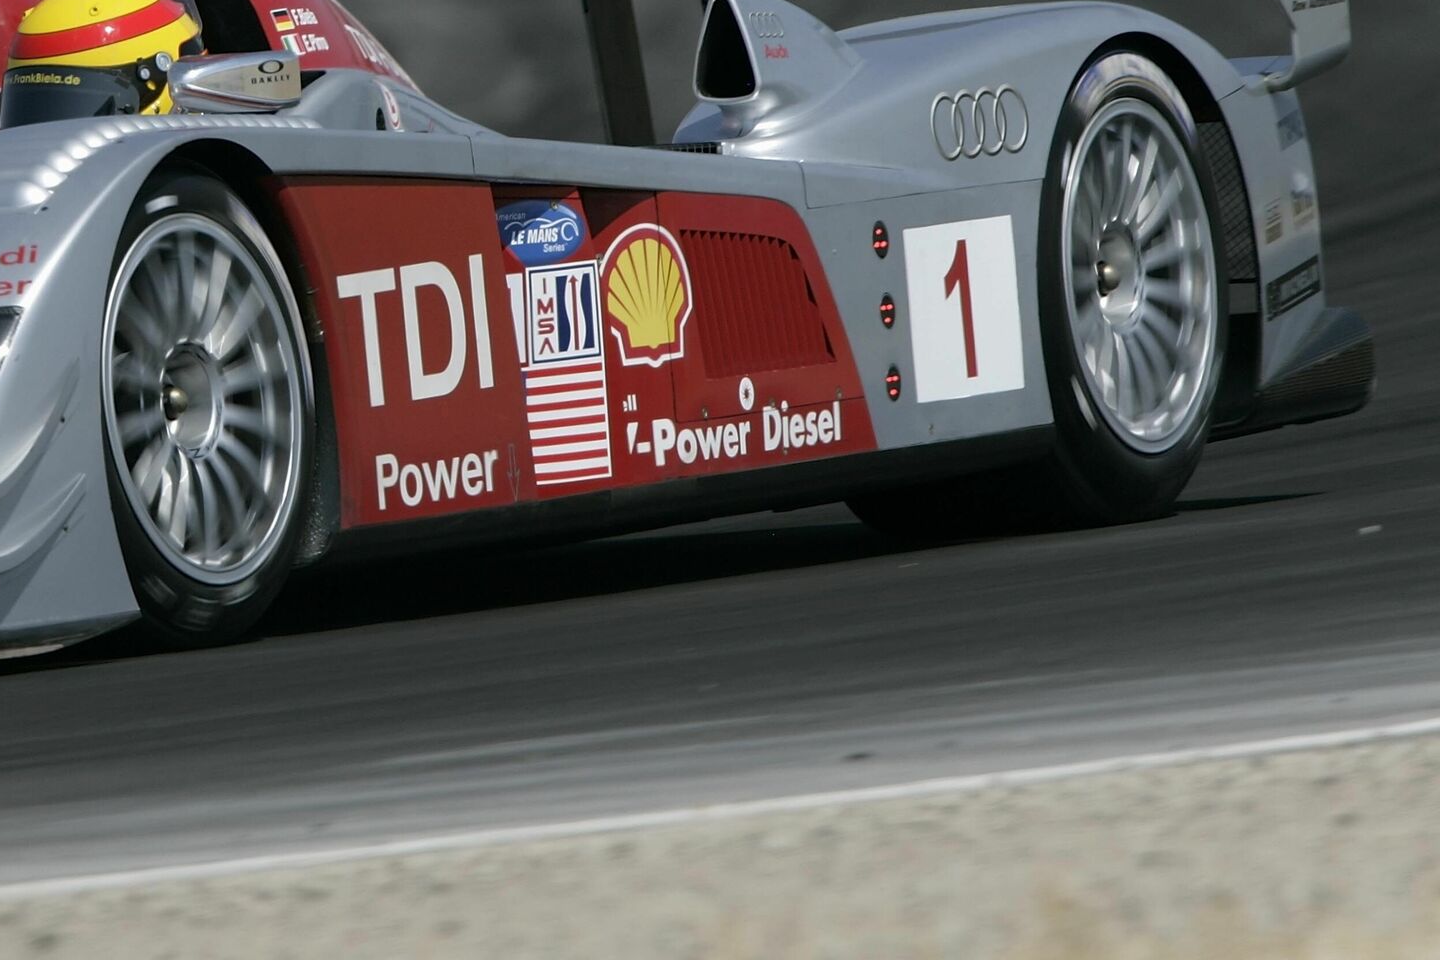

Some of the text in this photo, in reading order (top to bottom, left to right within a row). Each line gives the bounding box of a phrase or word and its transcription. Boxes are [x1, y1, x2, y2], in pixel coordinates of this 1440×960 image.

[251, 74, 290, 84] OAKLEY
[511, 227, 558, 245] LE MANS
[543, 242, 566, 253] Series
[336, 254, 494, 407] TDI
[536, 278, 555, 355] IMSA
[944, 239, 978, 379] 1
[763, 399, 842, 451] Diesel
[374, 449, 499, 511] Power
